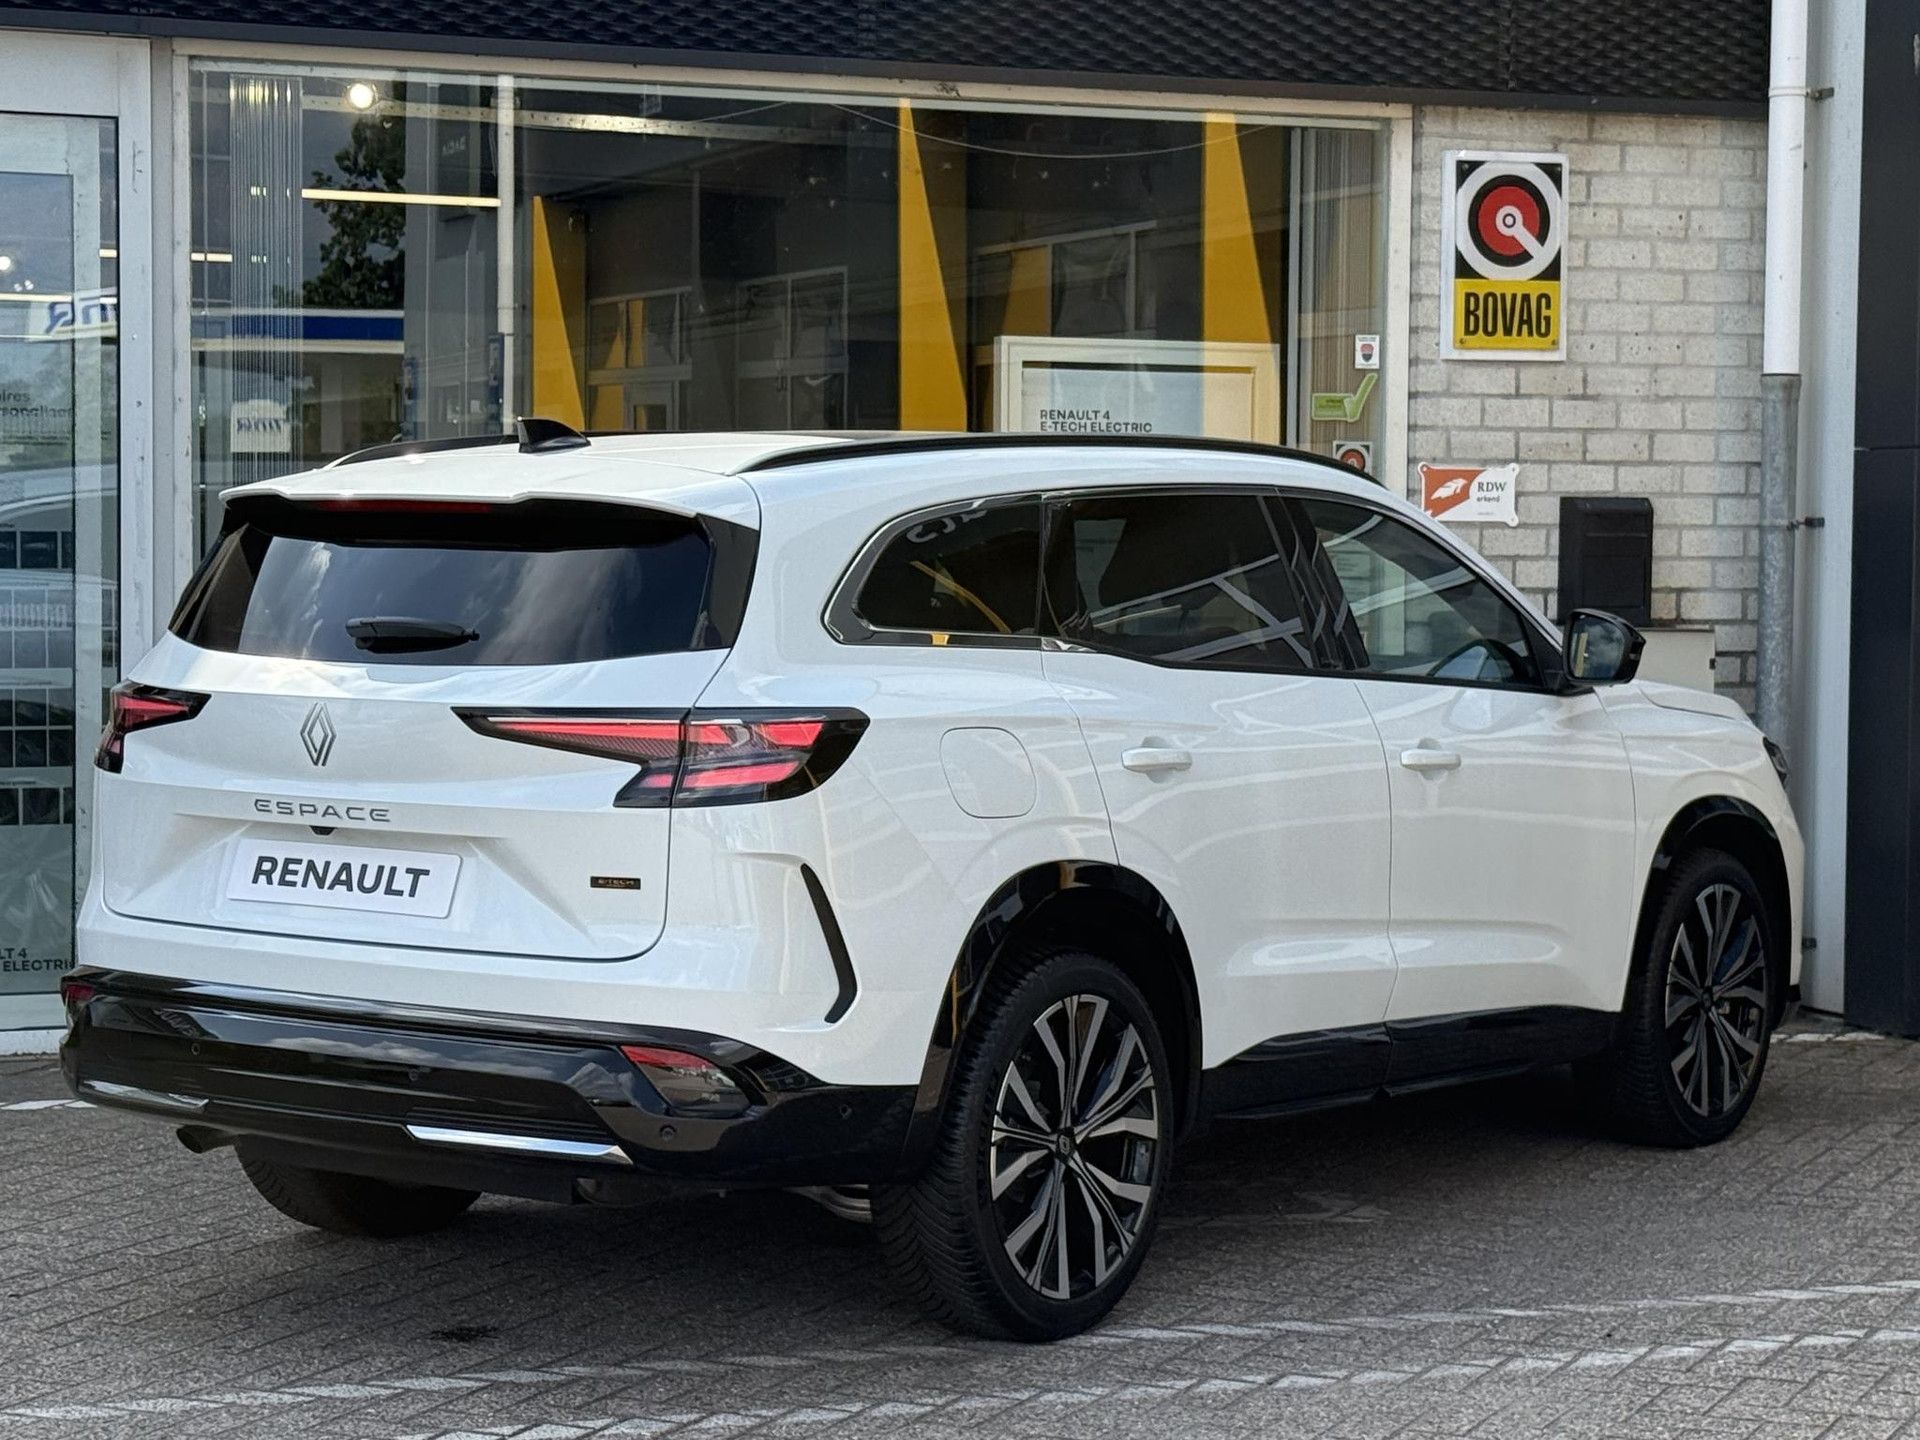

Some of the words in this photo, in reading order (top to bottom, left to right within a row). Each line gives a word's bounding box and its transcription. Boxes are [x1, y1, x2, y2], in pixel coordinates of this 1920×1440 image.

[1463, 291, 1552, 338] BOVAG
[1040, 409, 1100, 421] RENAULT
[1102, 410, 1110, 420] 4
[1040, 421, 1087, 432] E-TECH
[1090, 421, 1153, 433] ELECTRIC
[1477, 481, 1507, 492] RDW
[254, 798, 391, 823] ESPACE
[251, 855, 431, 898] RENAULT
[17, 947, 27, 959] 4
